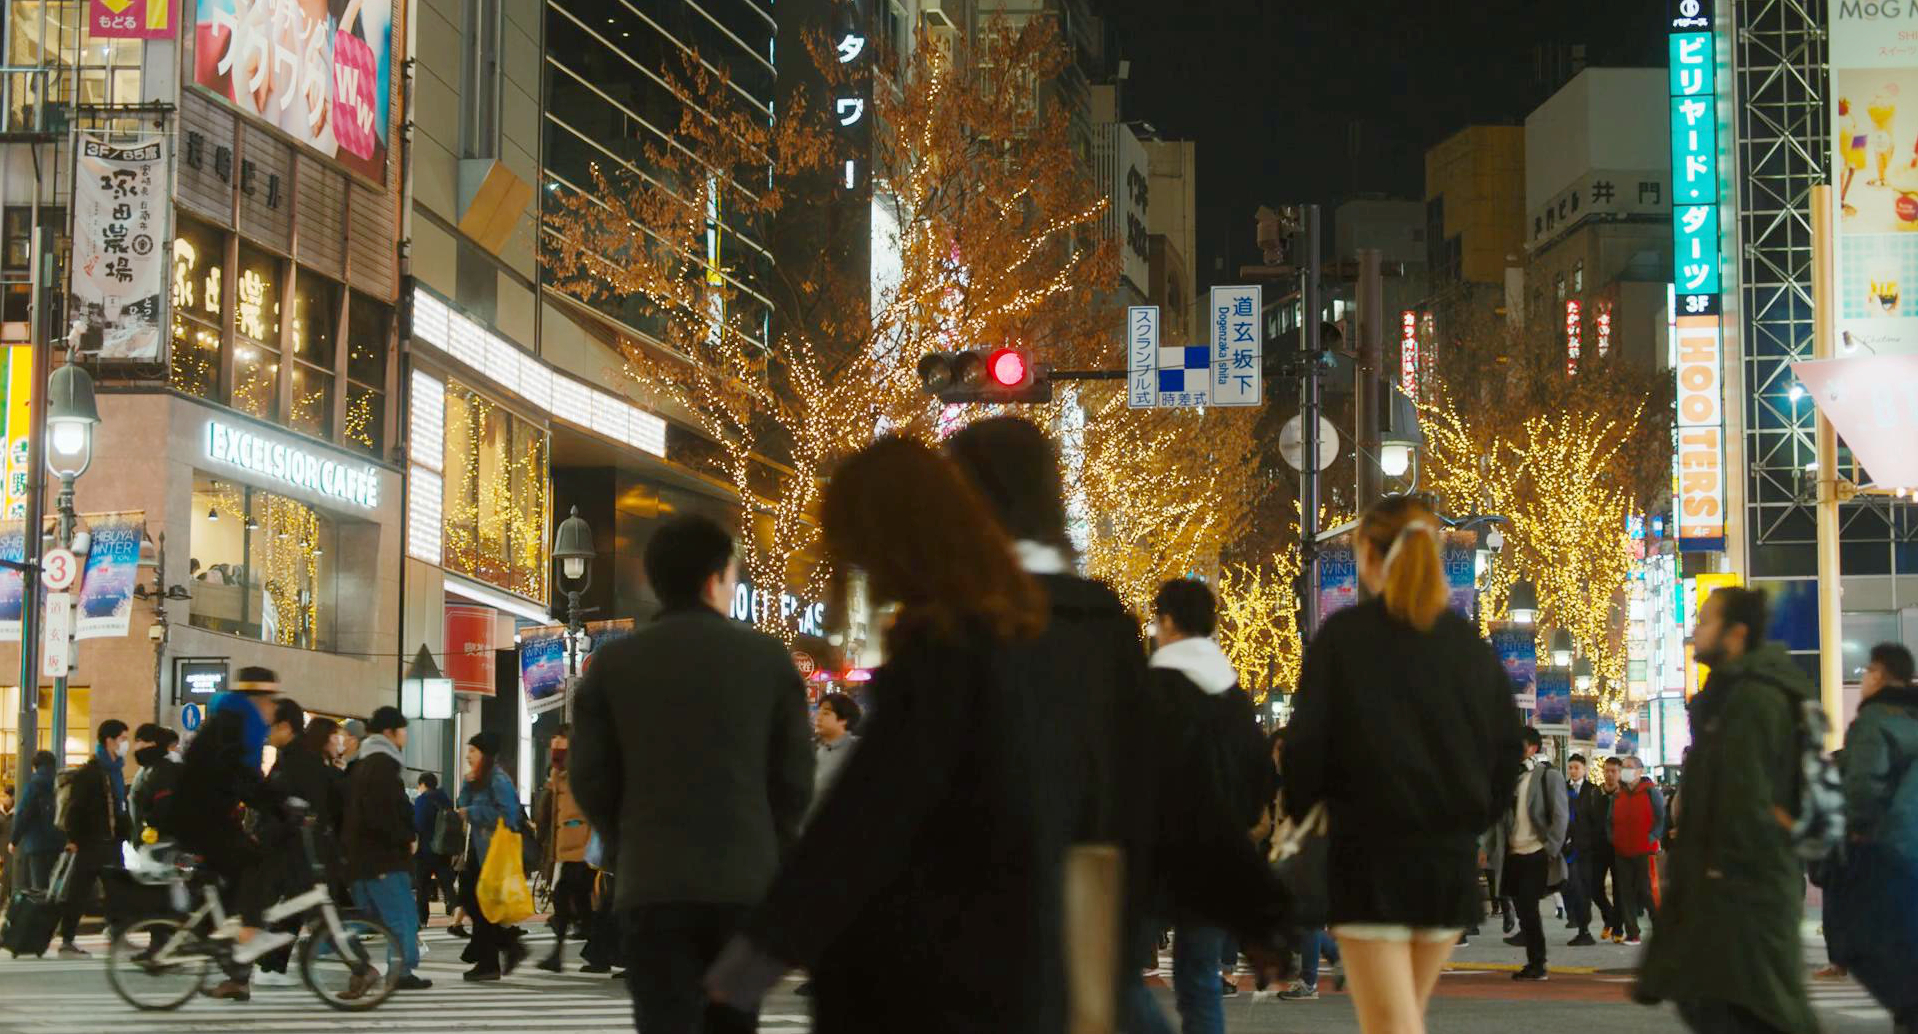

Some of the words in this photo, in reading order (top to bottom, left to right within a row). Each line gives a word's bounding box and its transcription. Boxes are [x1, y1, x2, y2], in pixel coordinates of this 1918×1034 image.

[98, 15, 136, 29] もどる
[1685, 295, 1709, 313] 3F
[1135, 311, 1152, 405] スクランブル式
[1216, 306, 1230, 359] Dogenzaka
[1232, 297, 1255, 396] 道玄坂下
[1161, 392, 1208, 407] 時差式
[1680, 336, 1719, 518] HOOTERS
[211, 422, 318, 489] EXCELSIOR
[50, 556, 66, 583] 3
